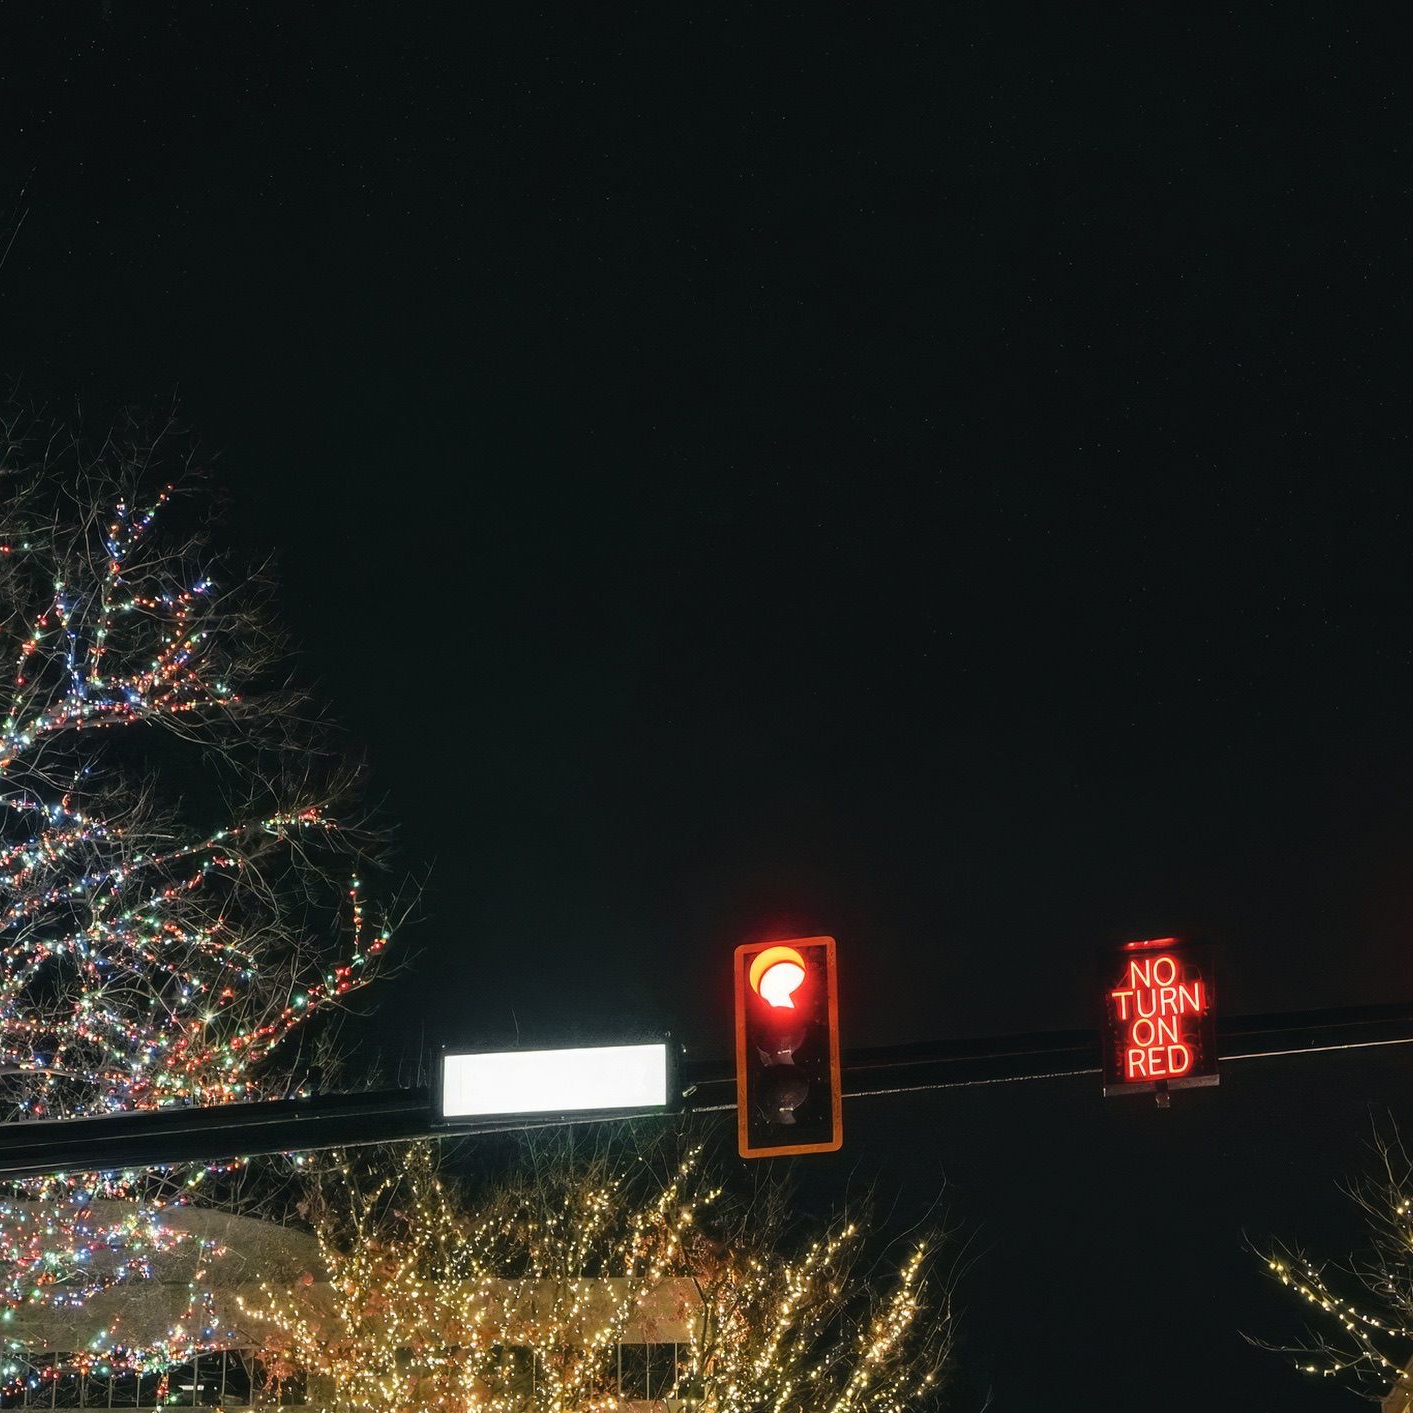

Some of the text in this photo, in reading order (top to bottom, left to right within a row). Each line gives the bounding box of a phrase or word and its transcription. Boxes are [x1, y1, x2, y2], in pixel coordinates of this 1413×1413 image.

[1130, 957, 1176, 989] NO
[1112, 982, 1200, 1020] TURN
[1132, 1015, 1178, 1047] ON
[1128, 1044, 1189, 1078] RED
